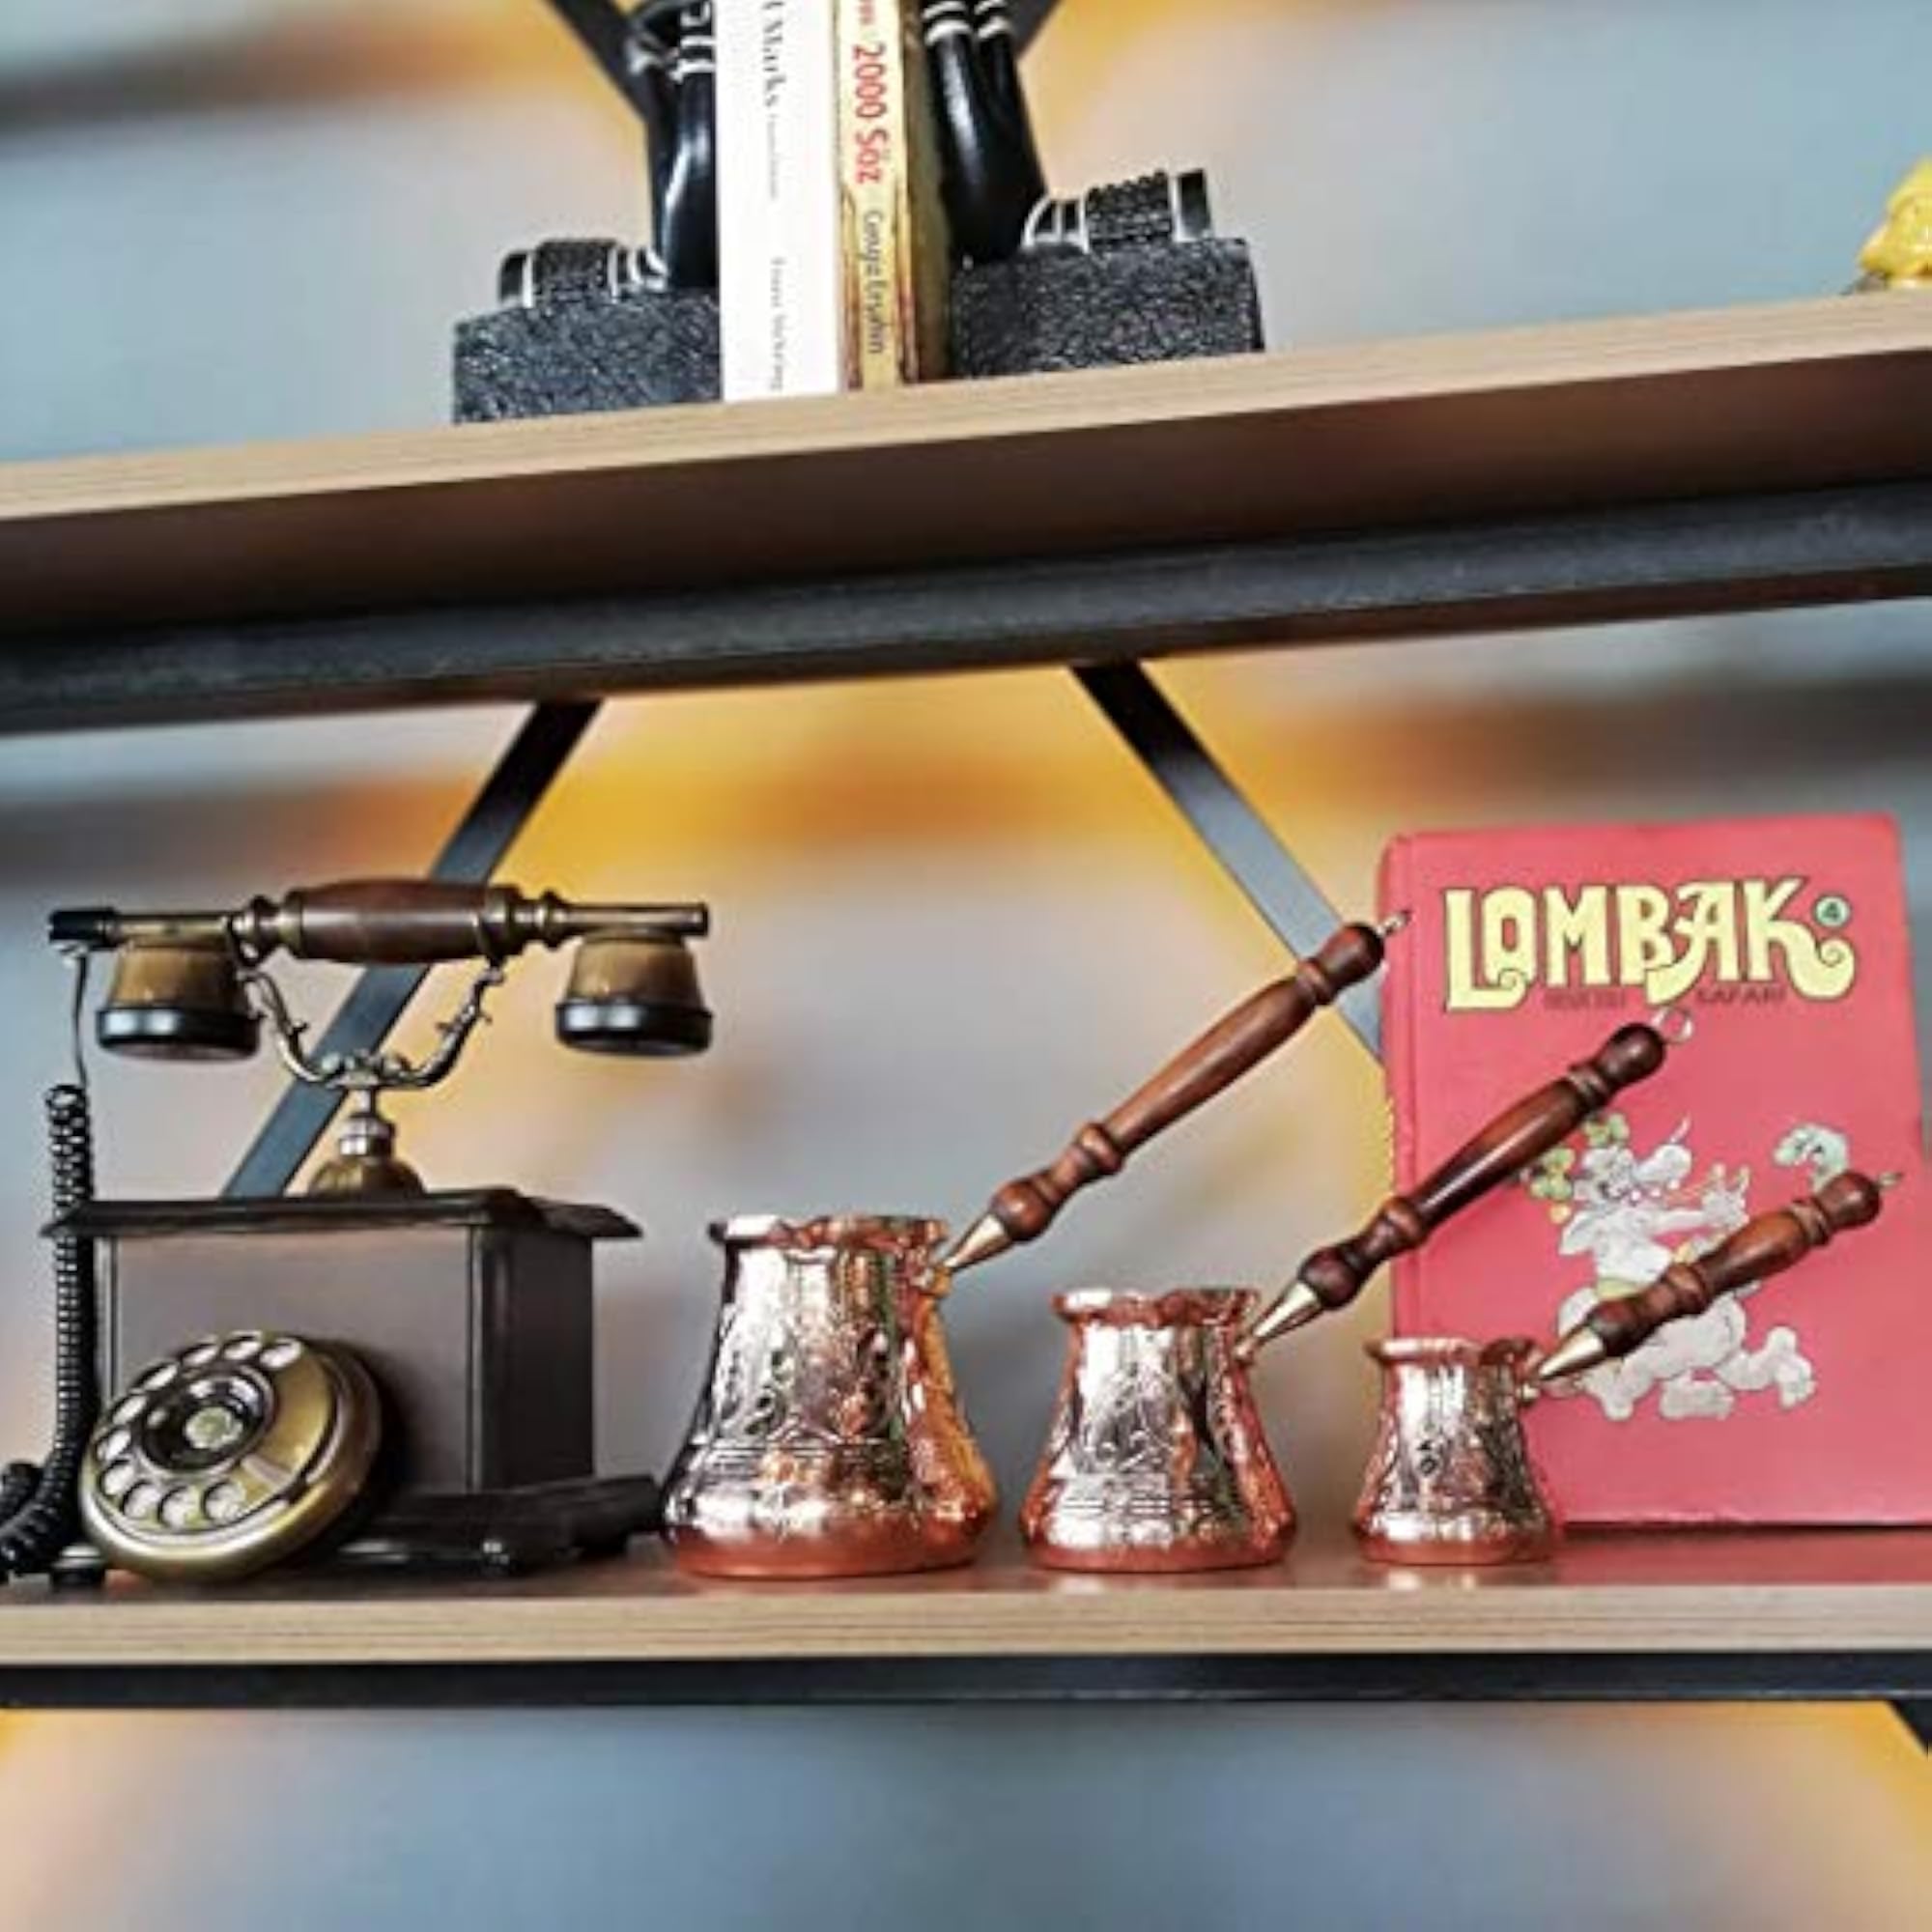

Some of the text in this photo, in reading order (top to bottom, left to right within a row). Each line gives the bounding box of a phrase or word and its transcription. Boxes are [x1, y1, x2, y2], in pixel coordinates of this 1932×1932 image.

[853, 42, 887, 119] 2000
[856, 128, 891, 184] Söz
[1443, 876, 1856, 1012] LOMBAK
